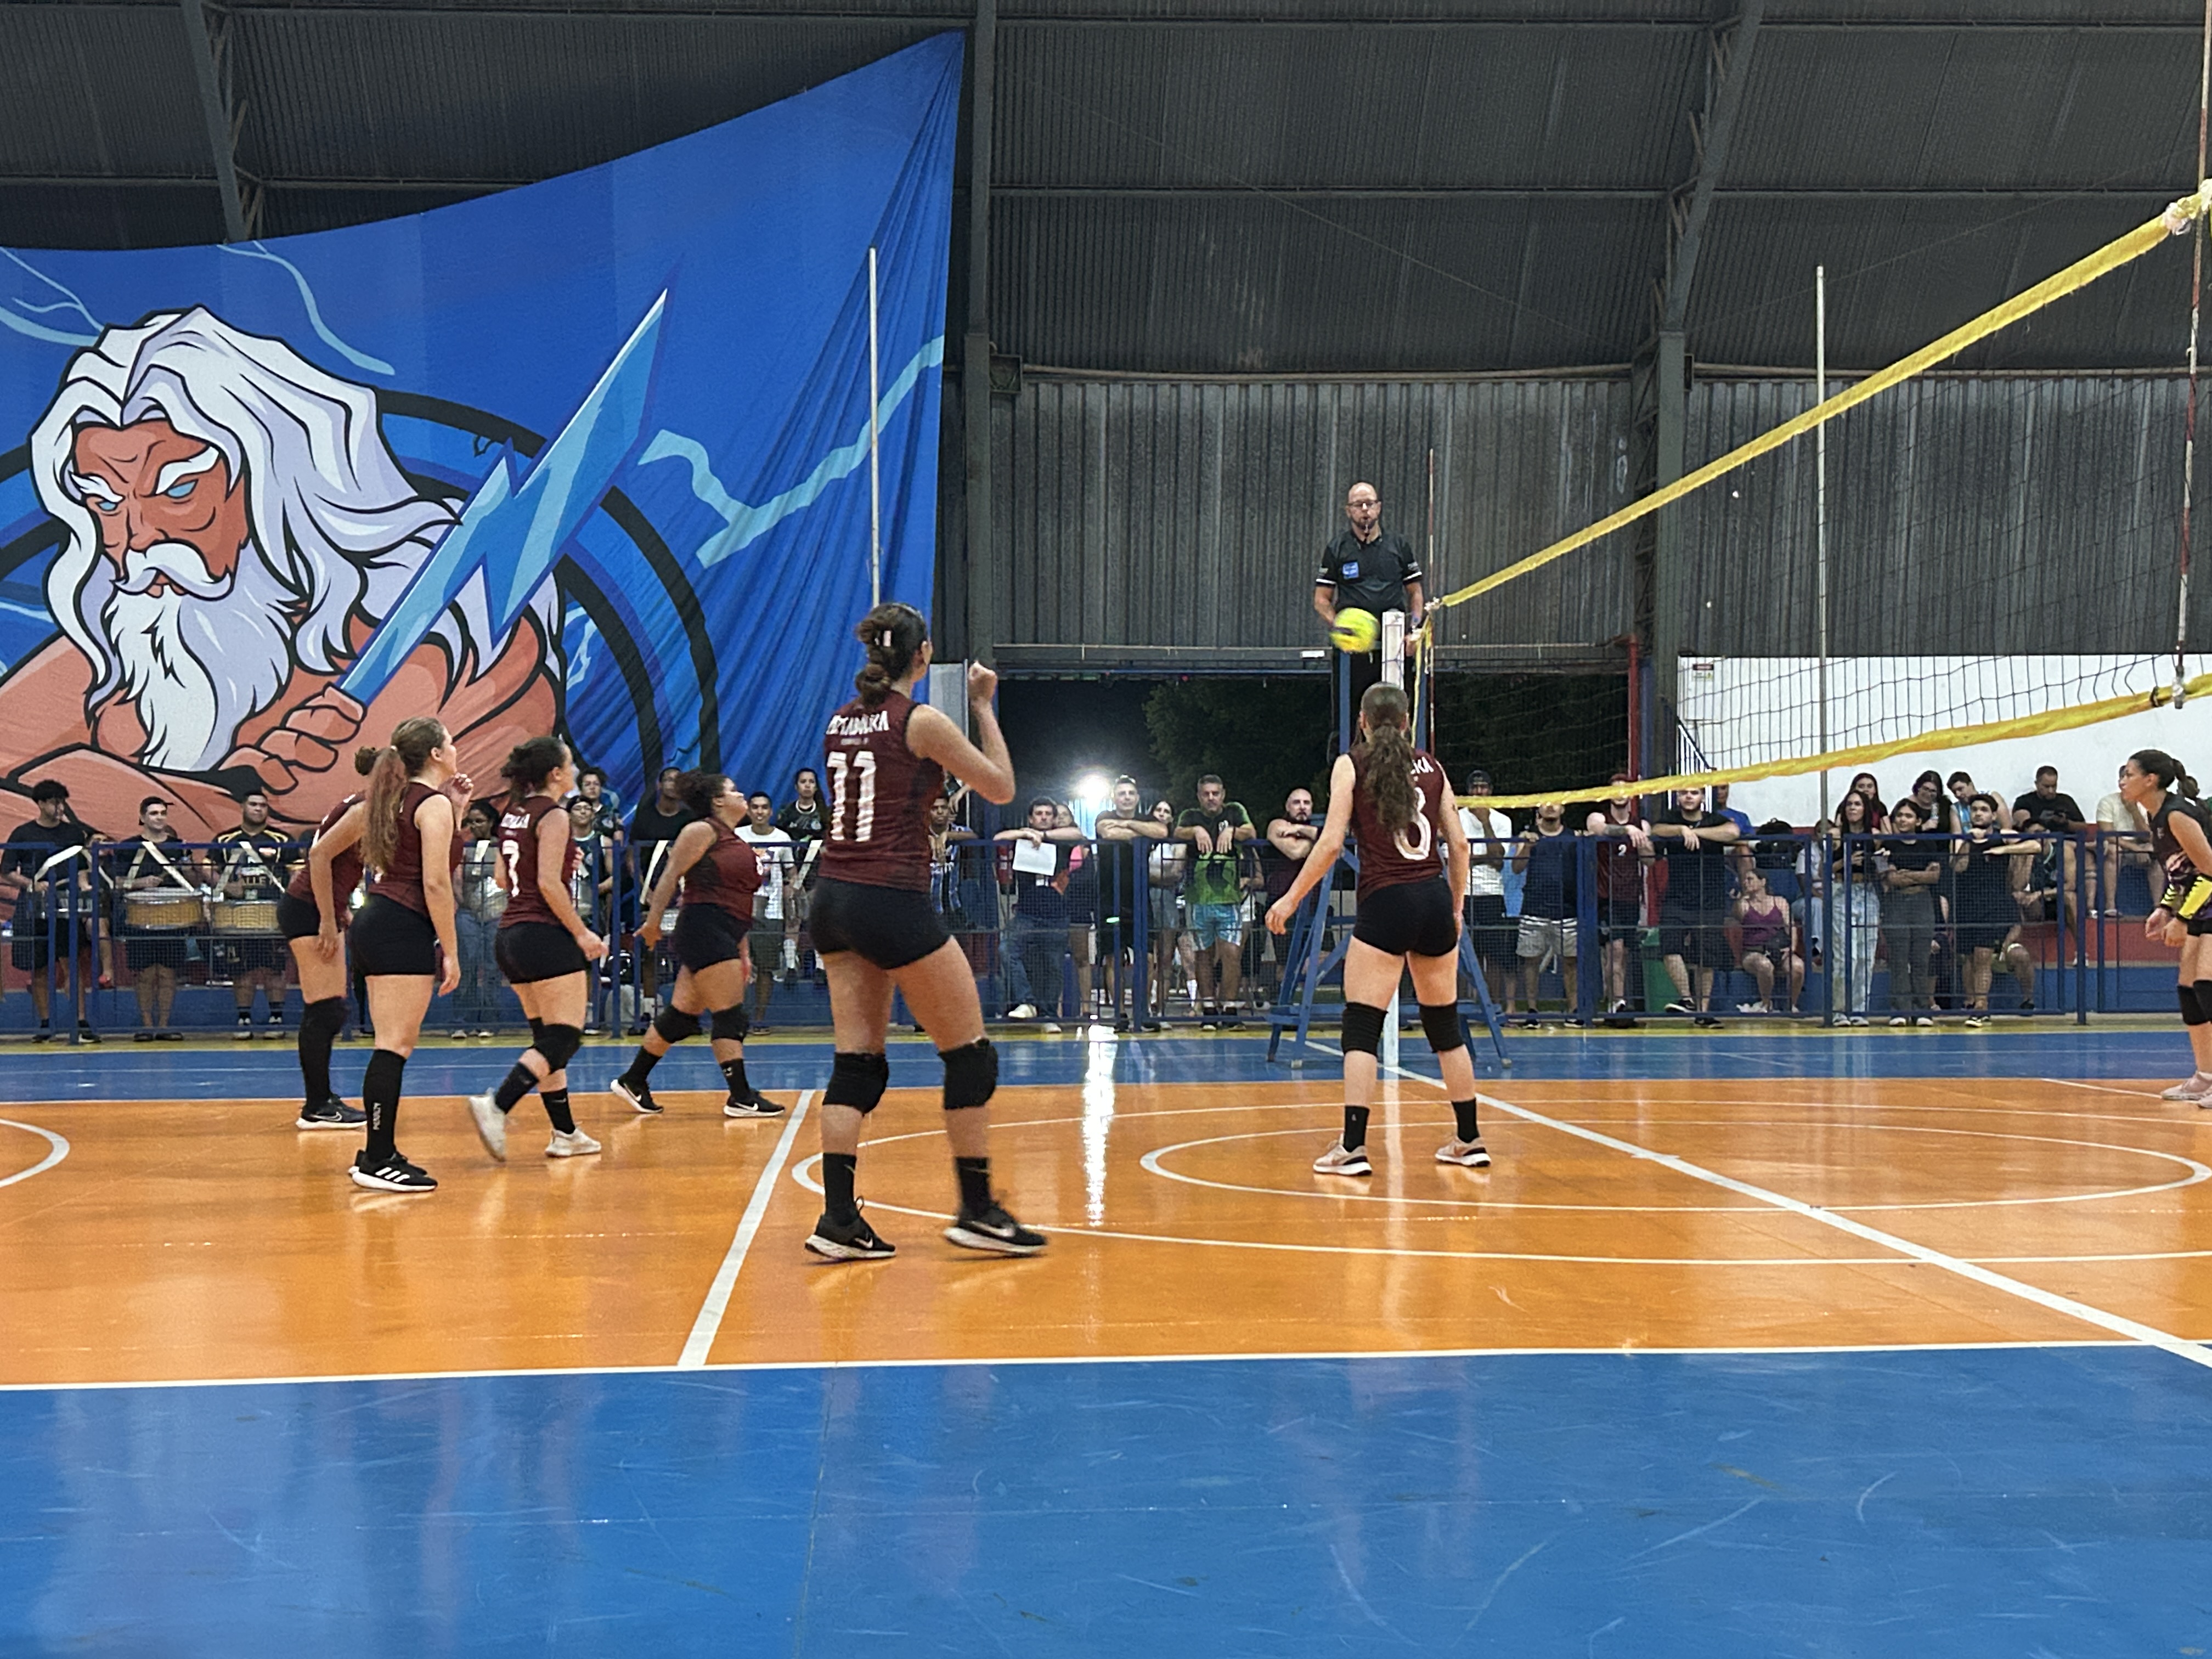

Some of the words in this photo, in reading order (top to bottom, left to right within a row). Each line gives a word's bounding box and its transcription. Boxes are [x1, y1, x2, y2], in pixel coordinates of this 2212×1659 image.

[827, 751, 876, 842] 11
[502, 839, 520, 897] 7
[1618, 844, 1627, 856] 2
